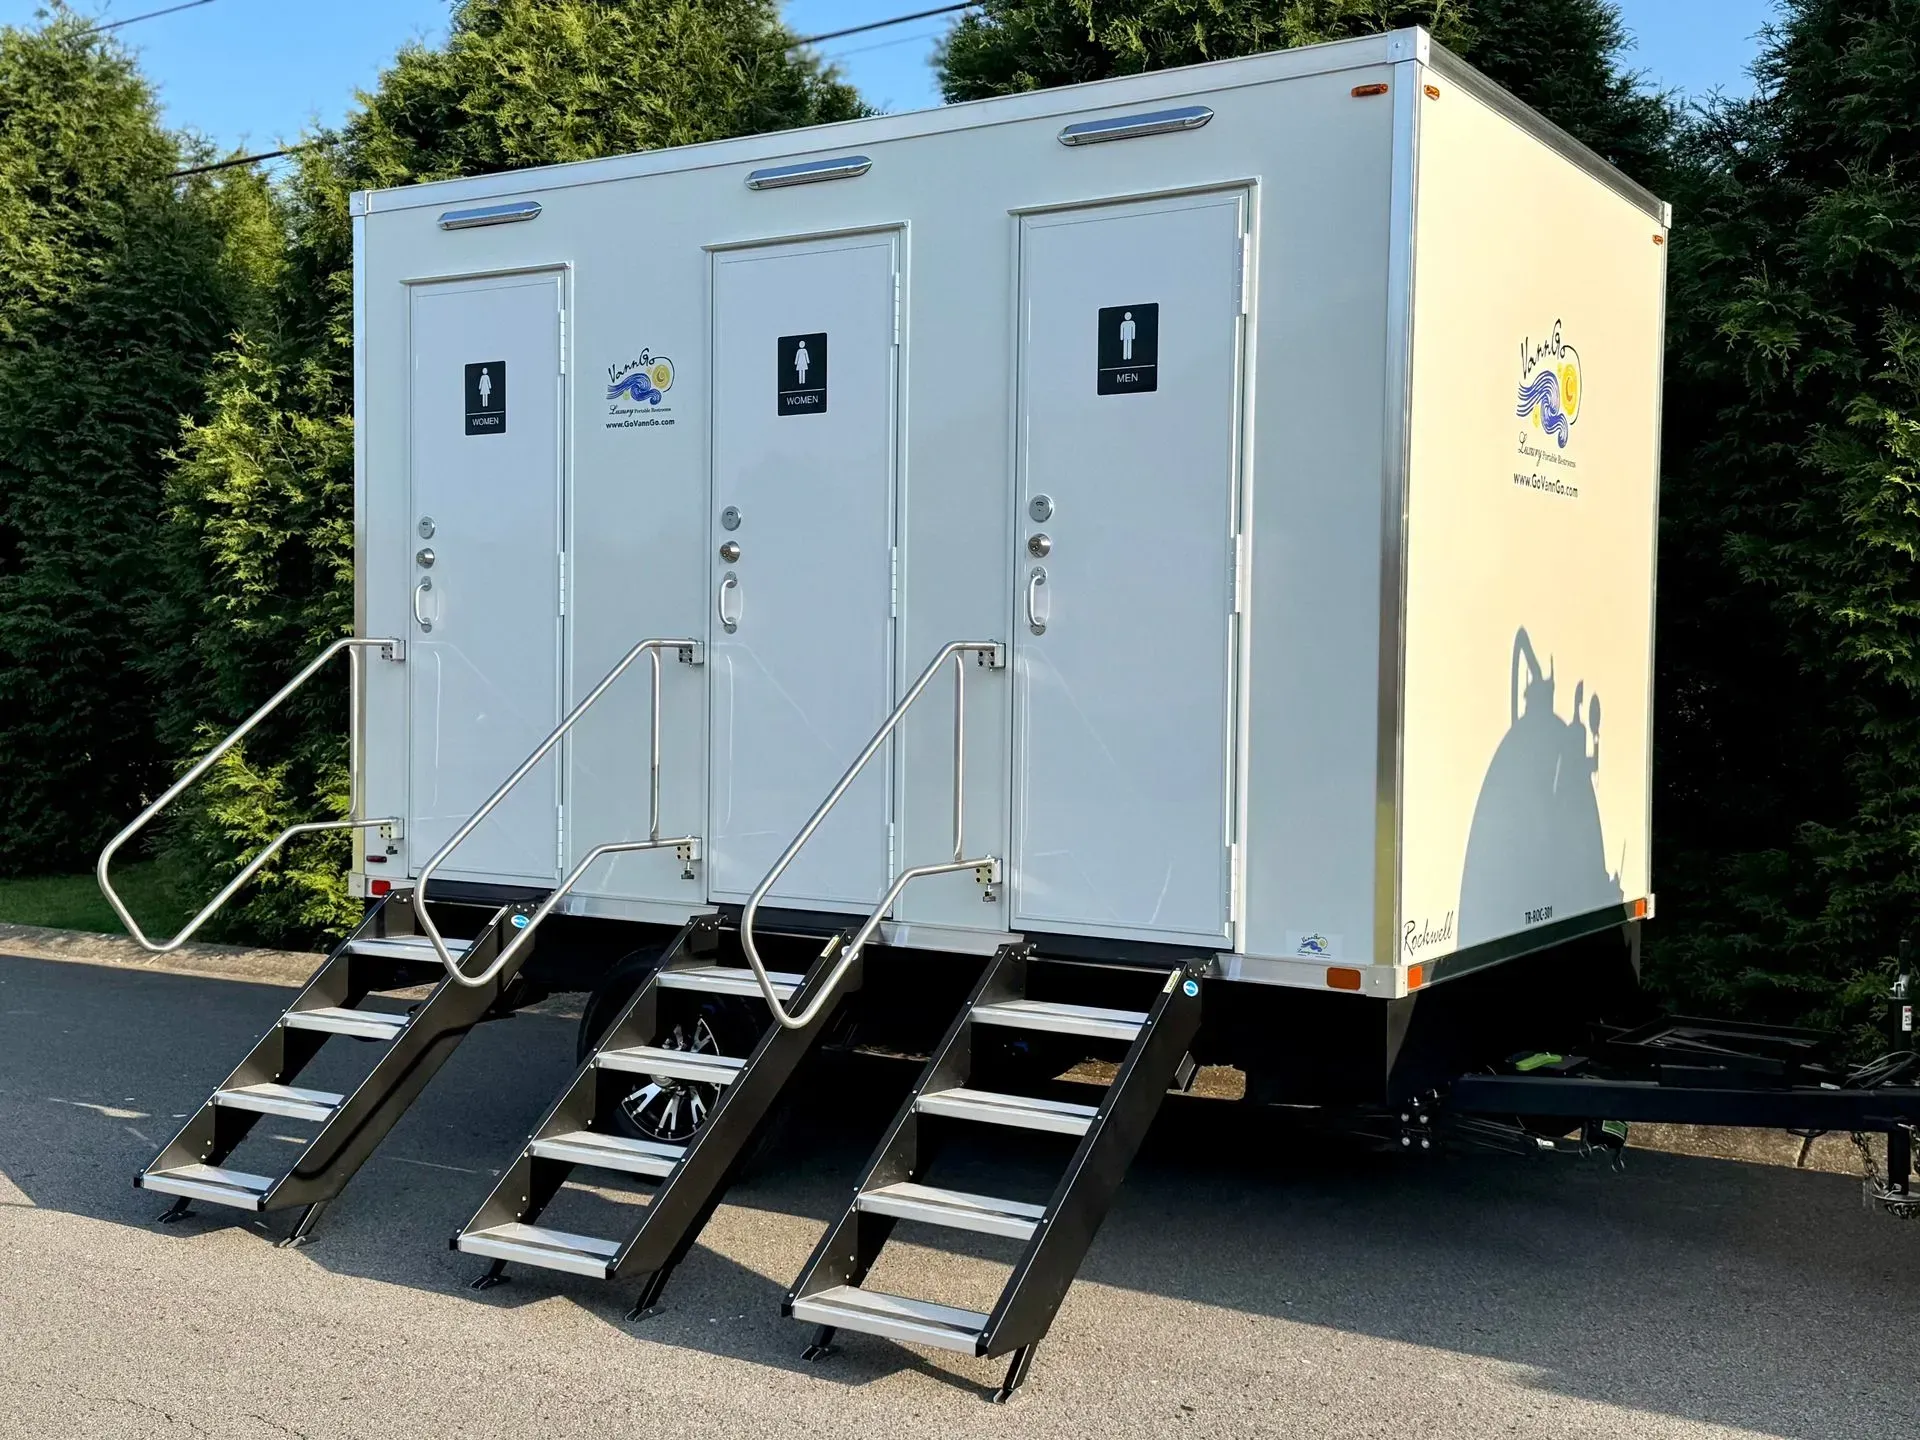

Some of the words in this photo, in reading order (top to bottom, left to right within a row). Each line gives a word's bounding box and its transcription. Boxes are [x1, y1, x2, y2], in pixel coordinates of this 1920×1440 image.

[1521, 318, 1566, 379] VannGo
[608, 348, 657, 383] VannGo
[1116, 373, 1139, 383] MEN
[786, 395, 819, 405] WOMEN
[609, 405, 634, 417] Luxury
[472, 417, 499, 426] WOMEN
[606, 419, 675, 429] www.GoVannGo.com
[1518, 431, 1542, 467] Luxury
[1513, 473, 1578, 497] www.GoVannGo.com
[1403, 910, 1454, 956] Rockwell
